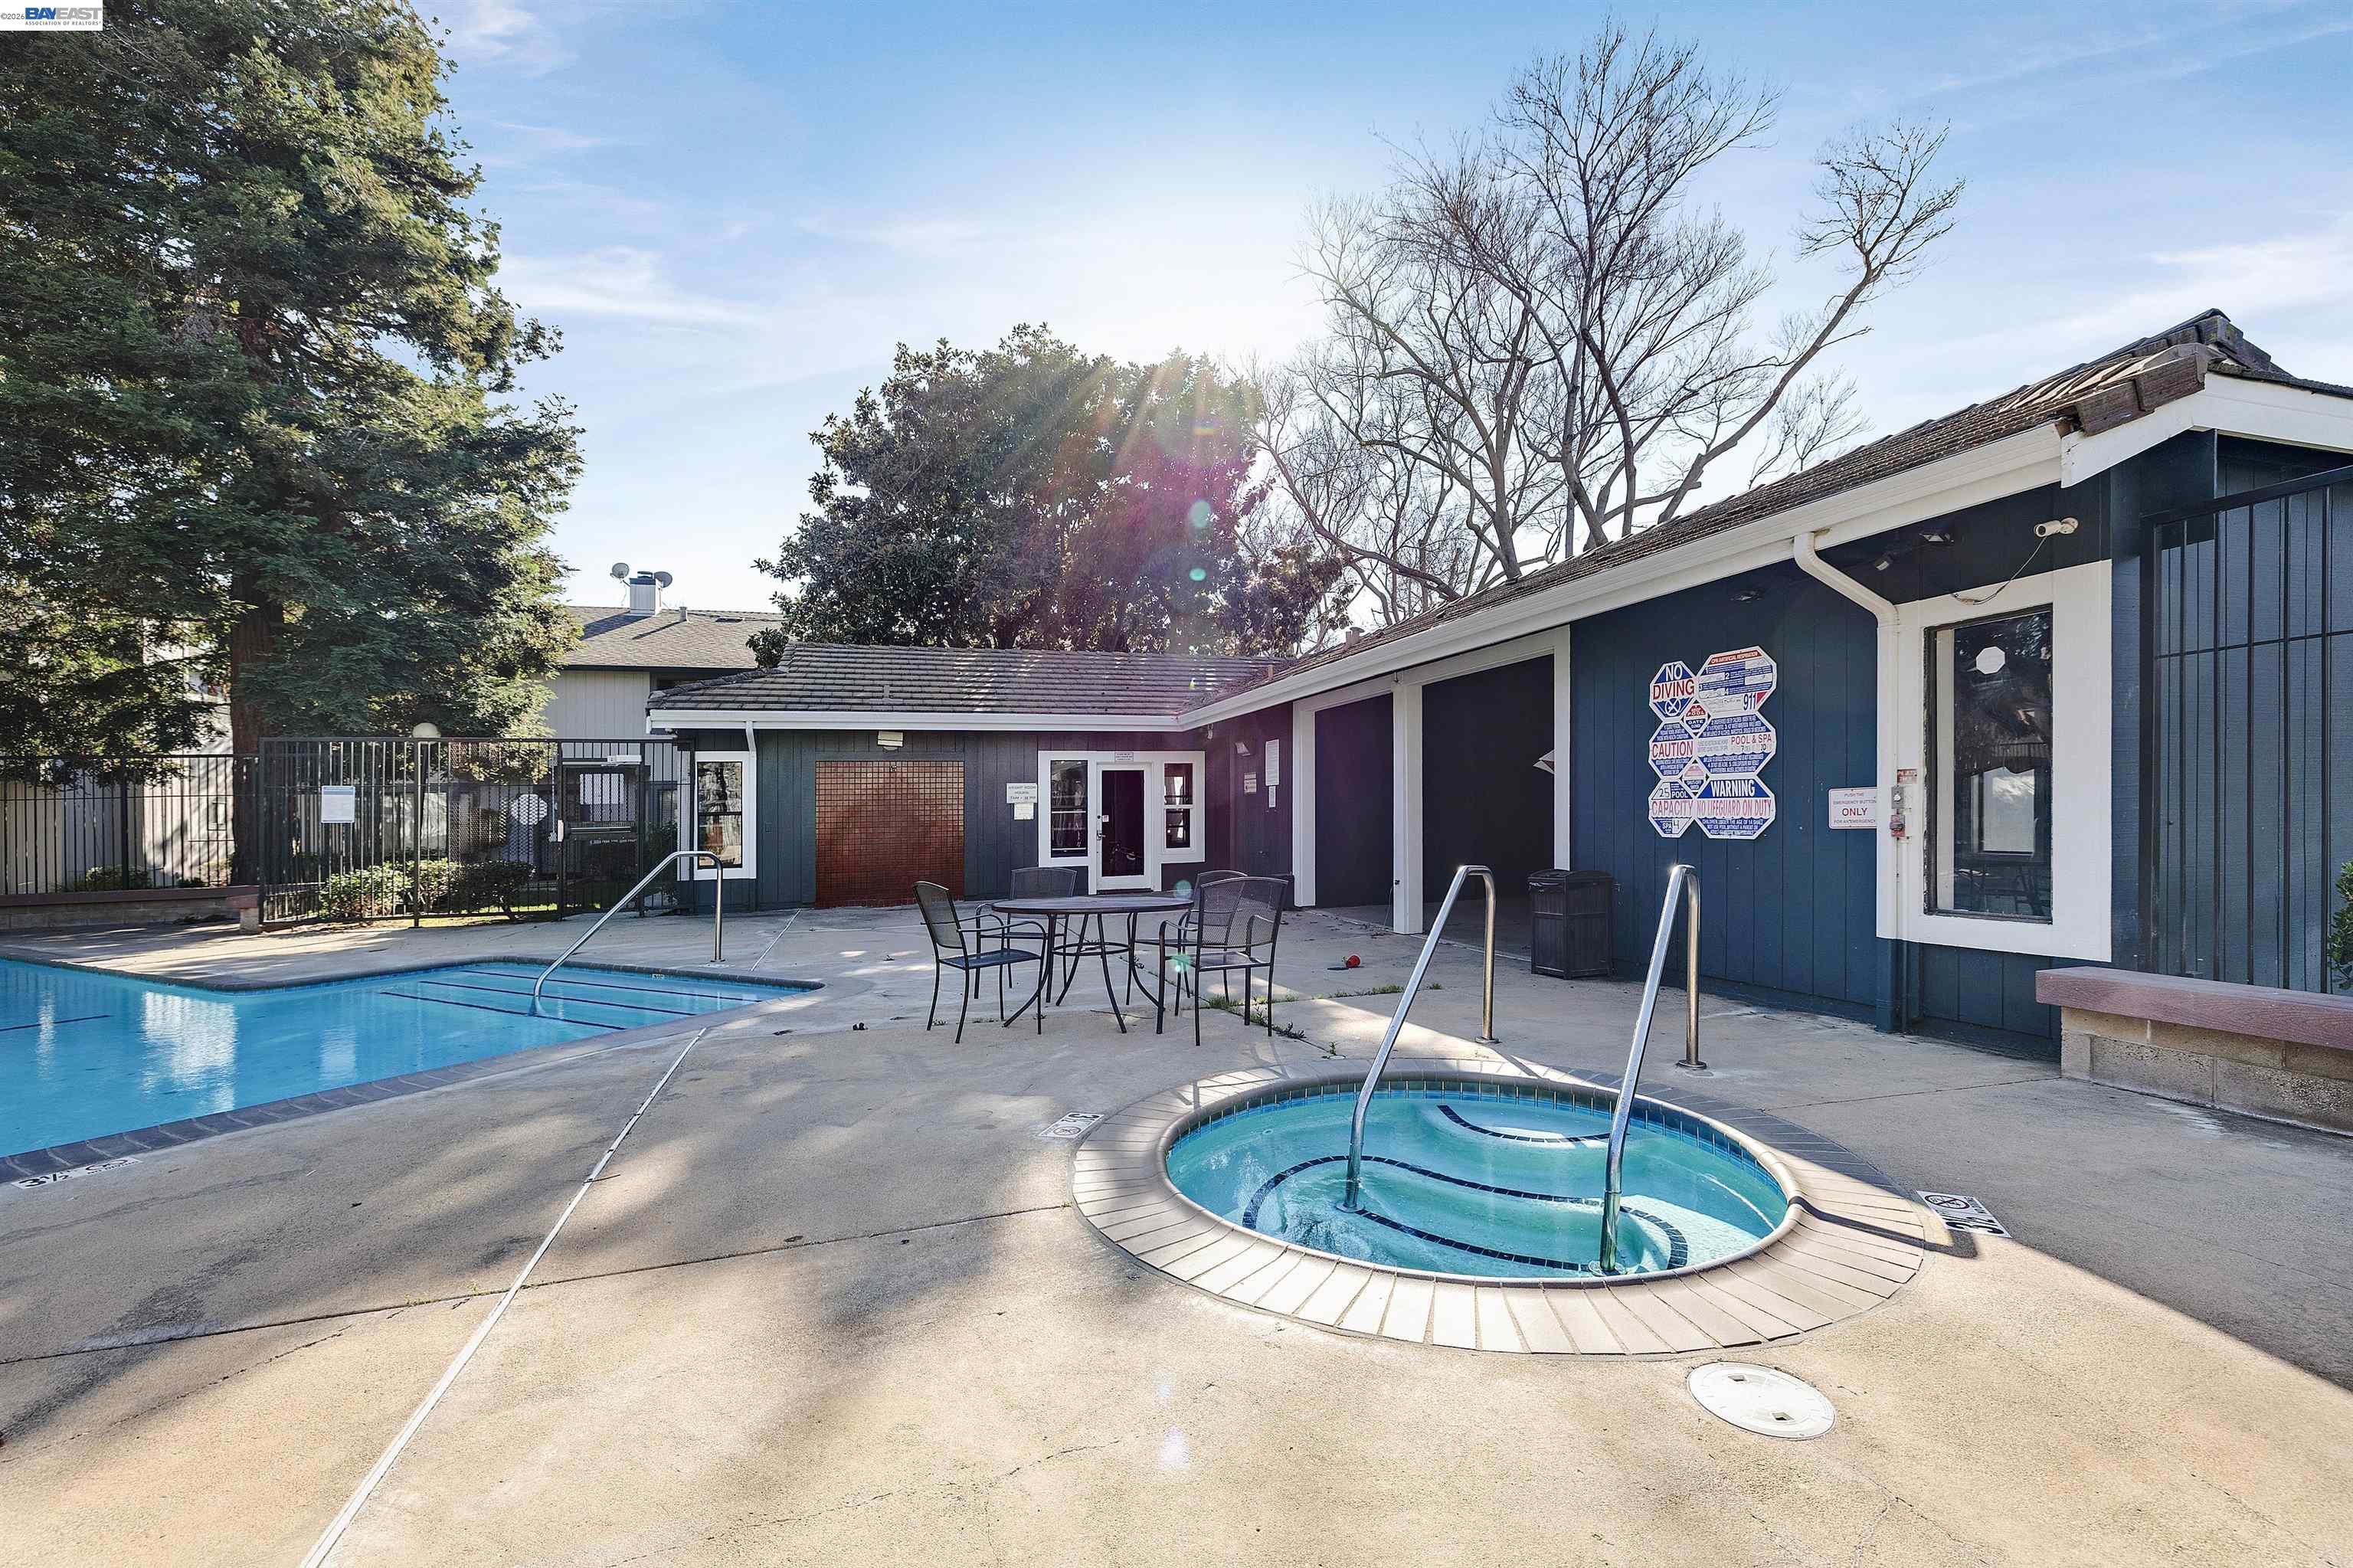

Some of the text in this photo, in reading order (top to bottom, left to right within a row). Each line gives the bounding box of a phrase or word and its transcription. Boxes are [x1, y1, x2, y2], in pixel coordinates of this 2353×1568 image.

[1666, 664, 1682, 682] NO
[1653, 679, 1694, 700] DIVING
[1743, 692, 1756, 711] 911
[1731, 735, 1750, 745] POOL
[1758, 734, 1772, 744] SPA
[1652, 741, 1693, 758] CAUTION
[1659, 787, 1670, 797] 25
[1710, 779, 1755, 797] WARNING
[1652, 800, 1694, 816] CAPACITY
[1697, 799, 1772, 817] NO LIFEGUARD ON DUTY
[1842, 807, 1867, 817] ONLY
[1674, 820, 1680, 830] 4
